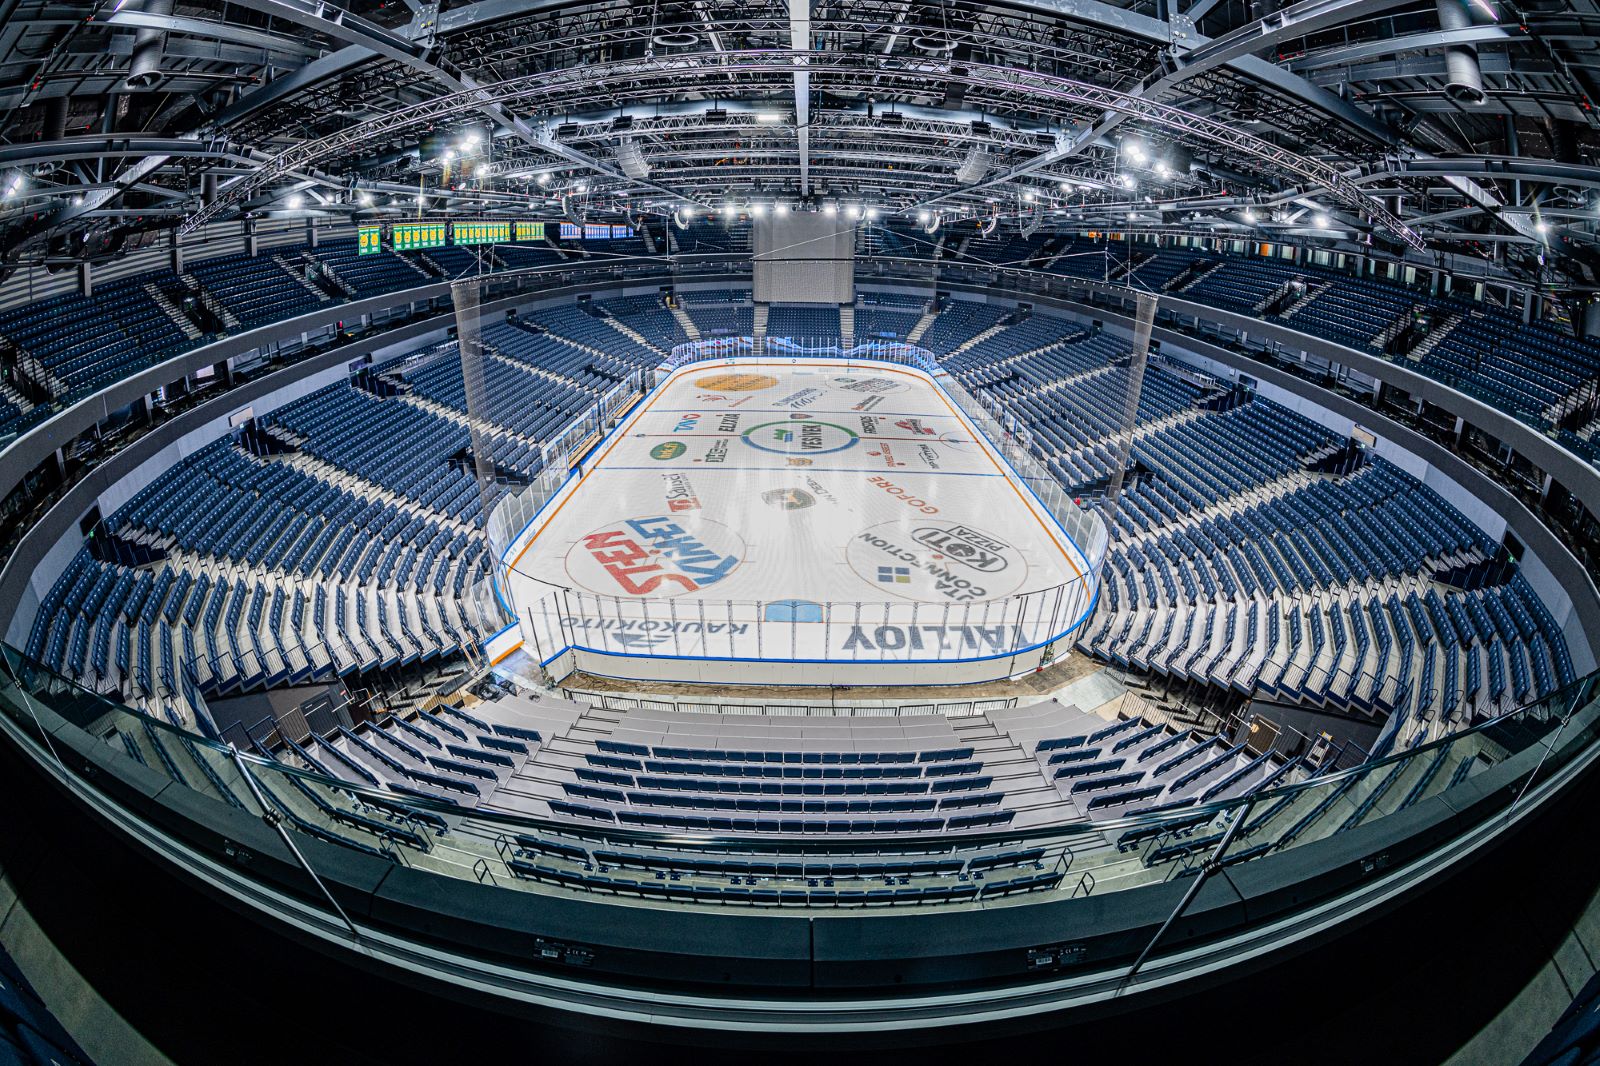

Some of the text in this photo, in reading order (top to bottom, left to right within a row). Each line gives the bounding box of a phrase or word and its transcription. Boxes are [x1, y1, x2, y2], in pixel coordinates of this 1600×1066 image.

[718, 413, 741, 433] ELIXIA
[866, 476, 939, 514] GOFORE
[625, 516, 739, 585] KIMET
[918, 530, 999, 569] KOTI
[957, 528, 1004, 552] PIZZA
[583, 530, 699, 595] STEN
[934, 579, 975, 600] JTA
[558, 617, 749, 635] KAUKOKIITO
